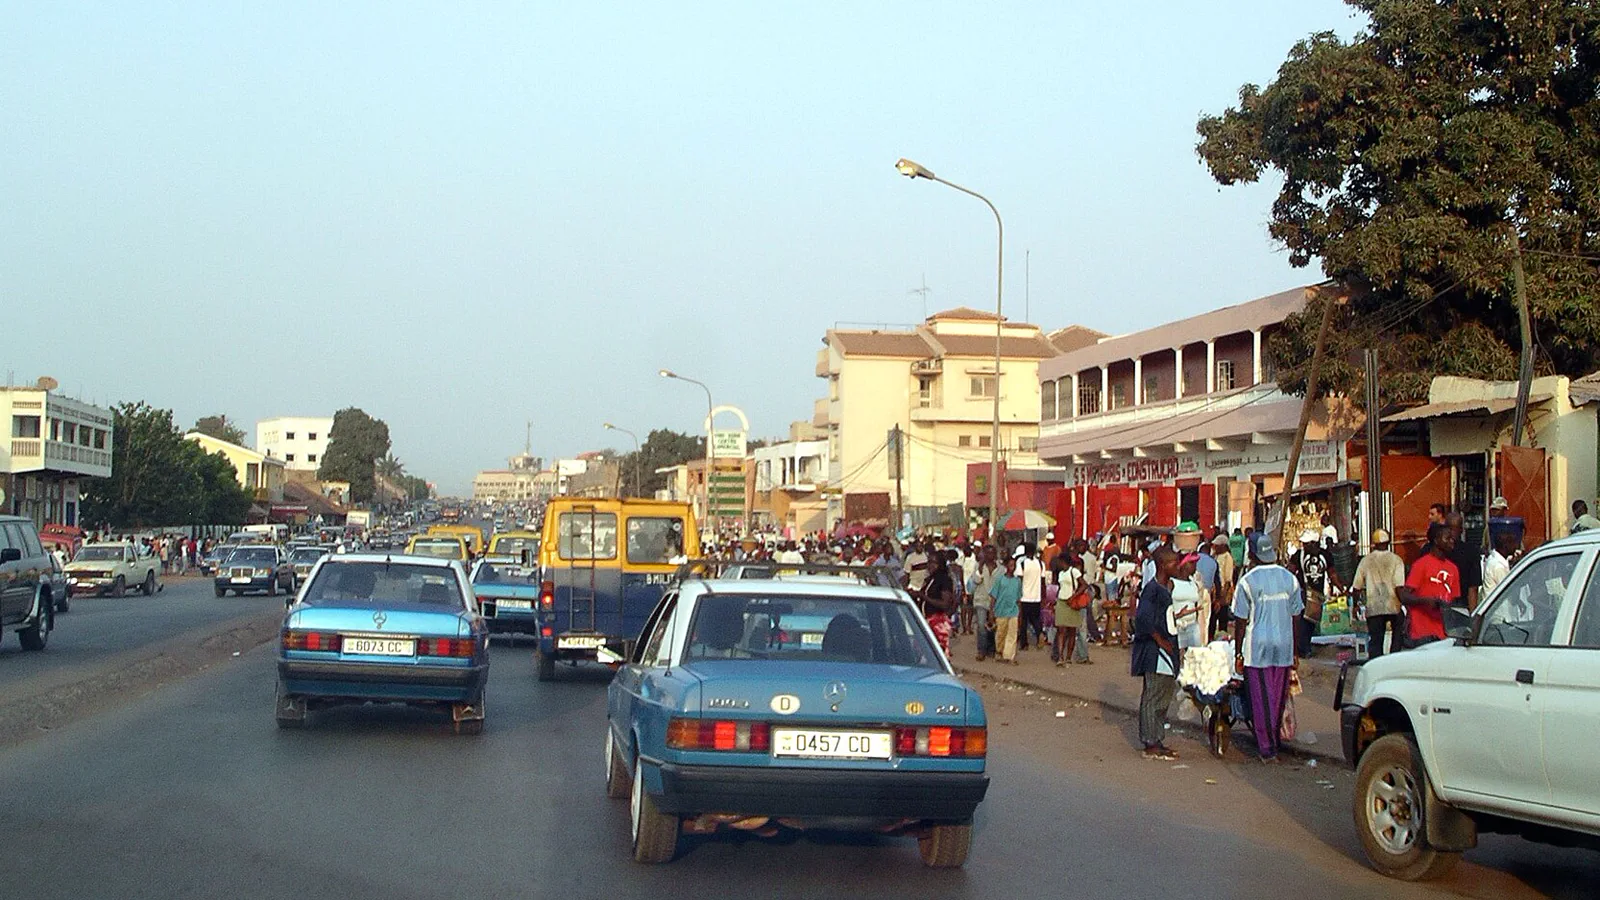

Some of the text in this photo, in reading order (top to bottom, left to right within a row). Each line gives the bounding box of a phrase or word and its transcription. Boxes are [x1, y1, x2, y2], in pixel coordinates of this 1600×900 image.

[355, 640, 402, 653] 6073 CC
[780, 697, 791, 711] D
[796, 734, 841, 753] 0457
